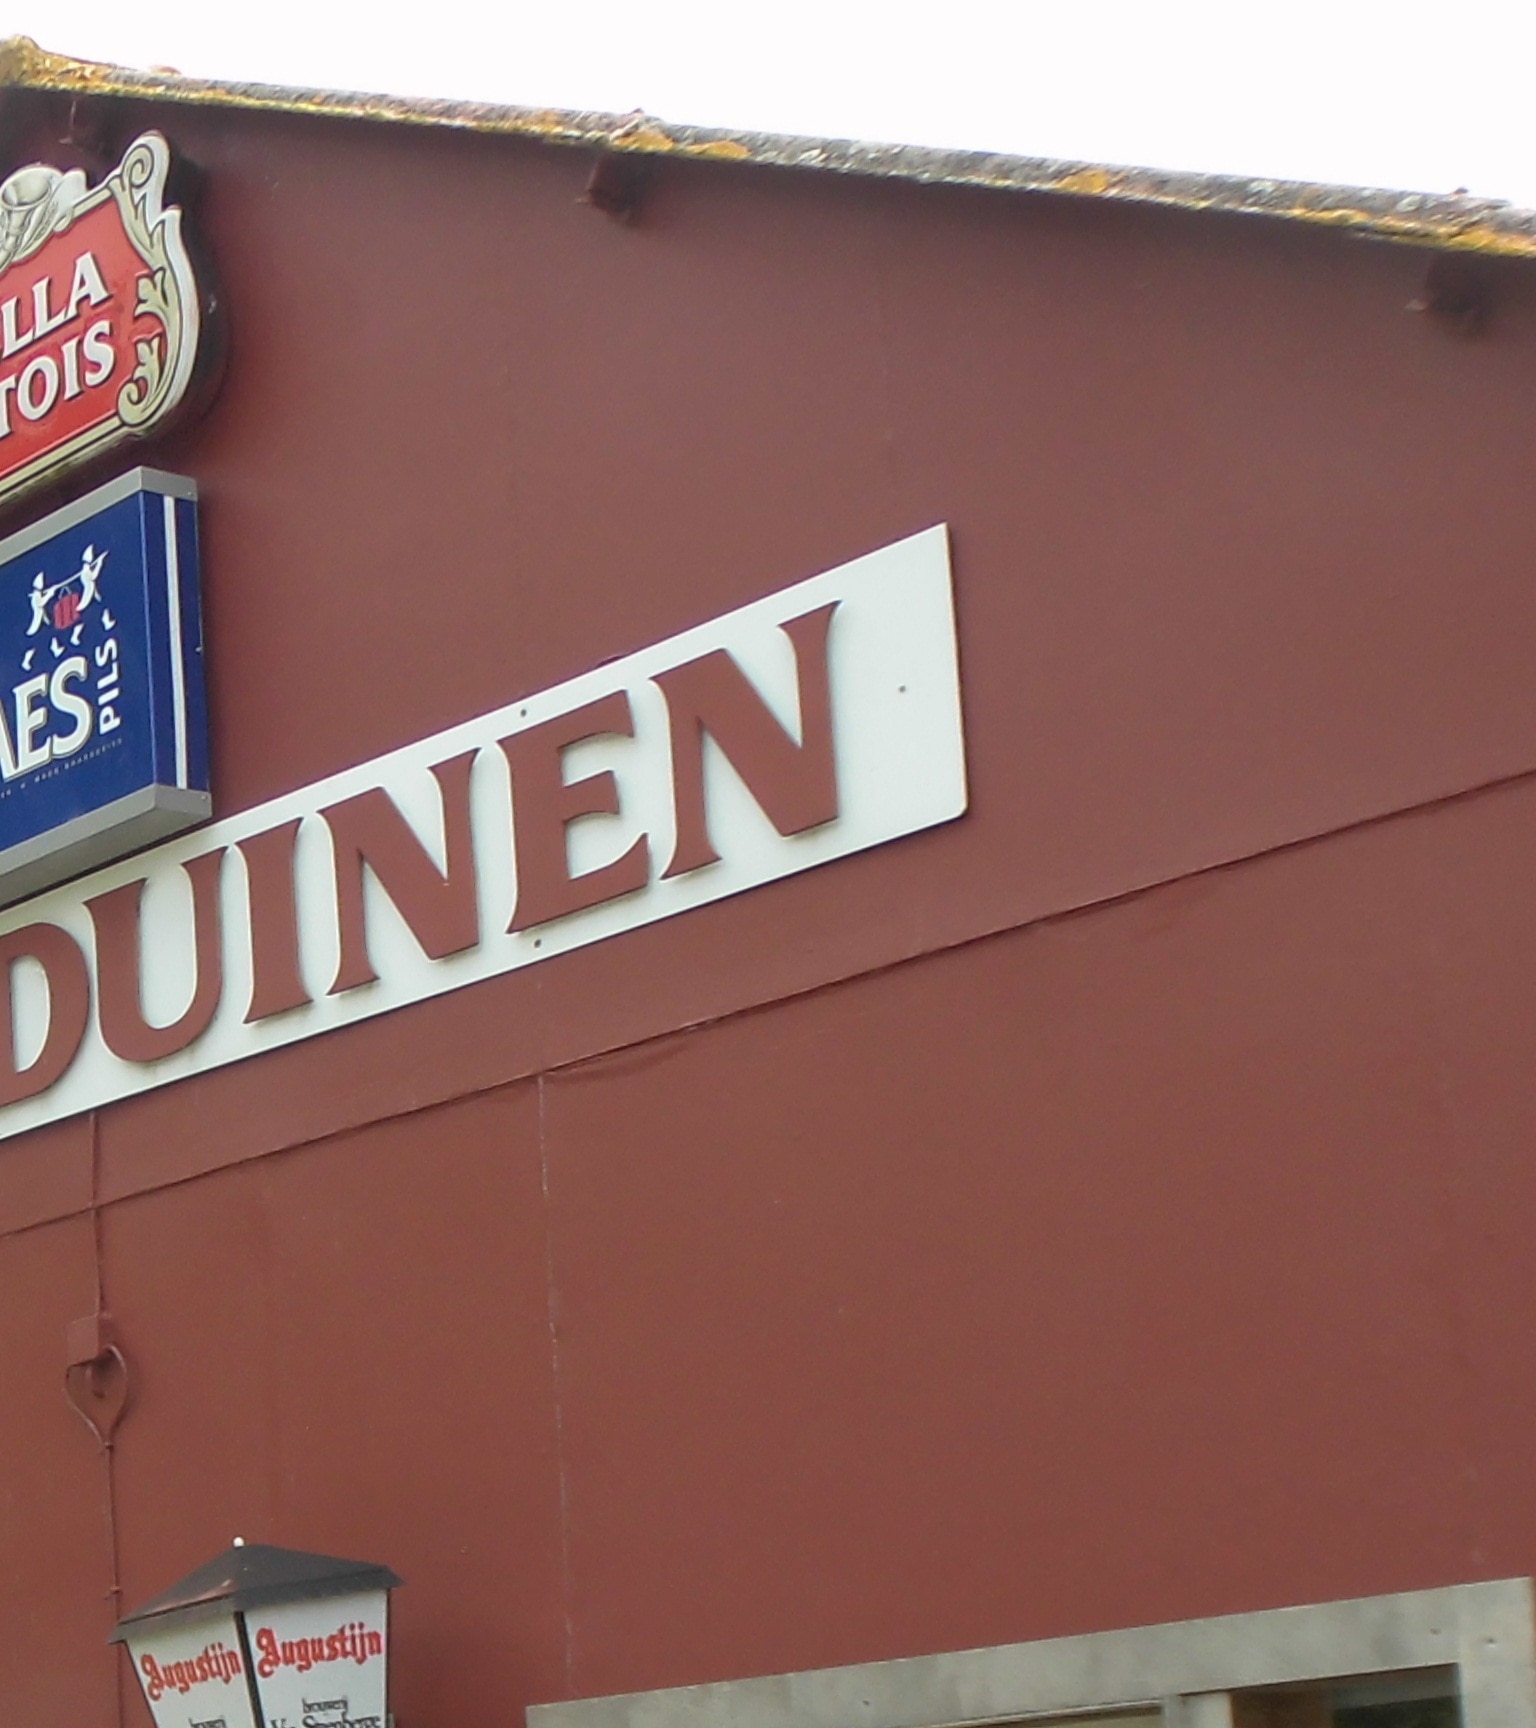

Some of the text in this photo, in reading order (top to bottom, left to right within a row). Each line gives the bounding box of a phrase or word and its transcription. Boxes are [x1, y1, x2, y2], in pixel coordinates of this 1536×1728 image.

[95, 637, 122, 736] PILS
[140, 1642, 242, 1701] Augustijn
[255, 1622, 382, 1679] Augustijn
